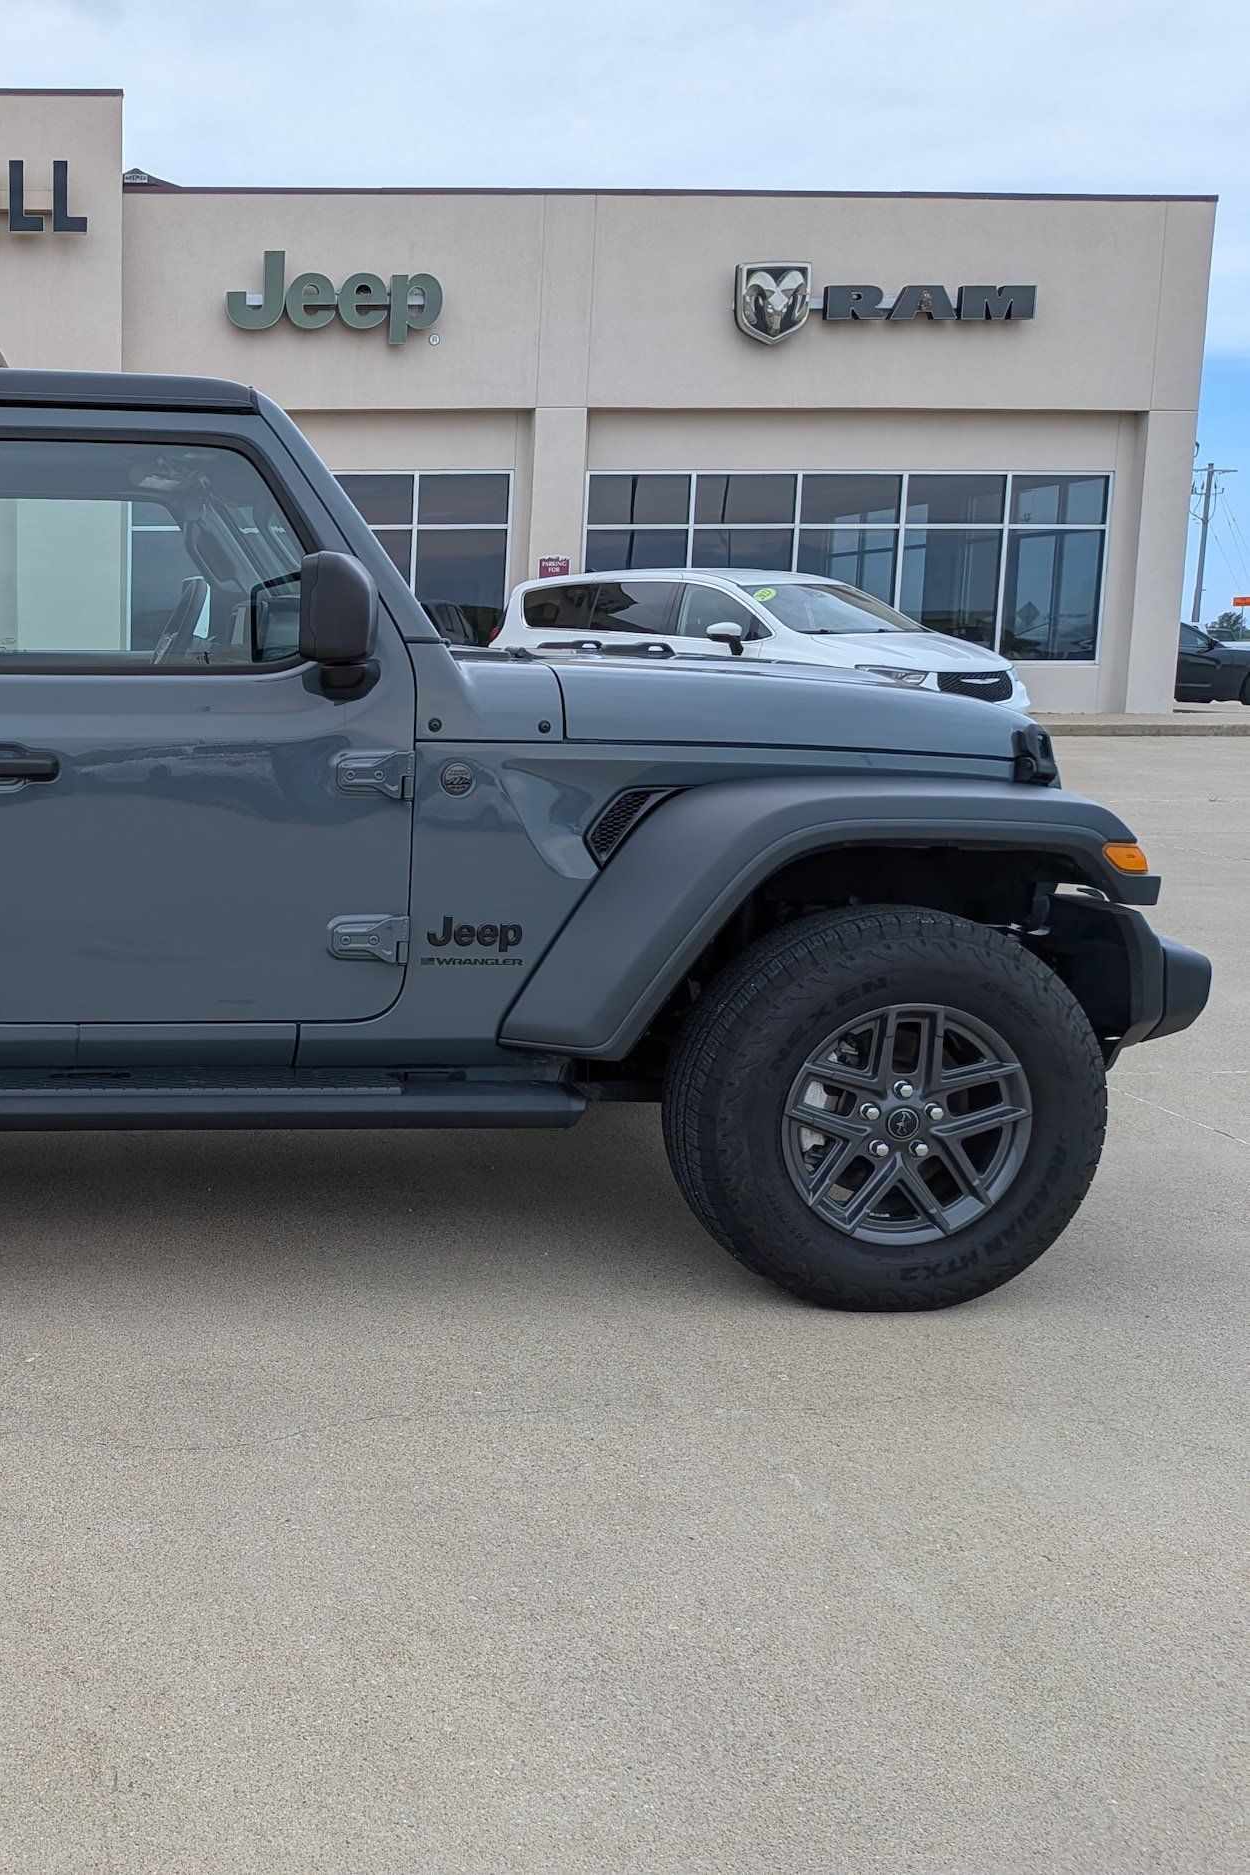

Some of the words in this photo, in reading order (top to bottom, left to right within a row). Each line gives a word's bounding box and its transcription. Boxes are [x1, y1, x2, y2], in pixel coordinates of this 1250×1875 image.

[226, 250, 443, 345] Jeep
[822, 284, 1038, 321] RAM
[427, 915, 523, 952] Jeep
[435, 957, 523, 966] WRANGLER
